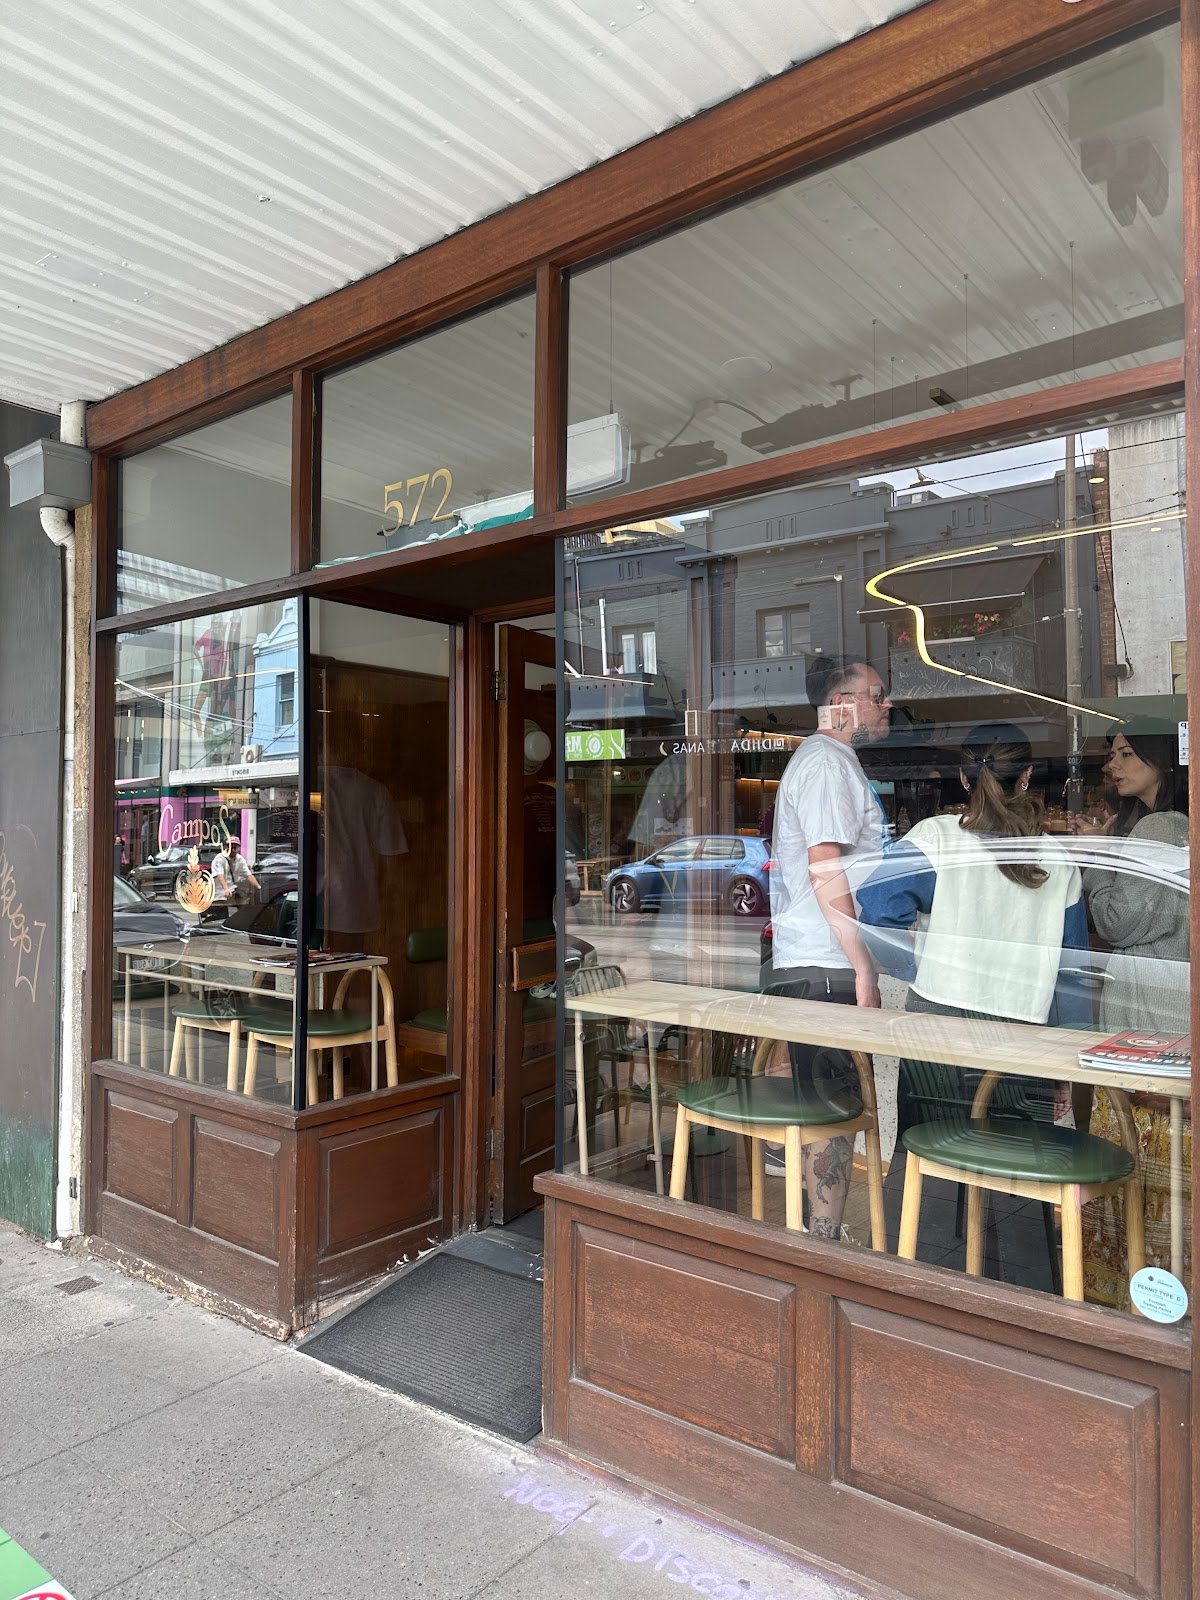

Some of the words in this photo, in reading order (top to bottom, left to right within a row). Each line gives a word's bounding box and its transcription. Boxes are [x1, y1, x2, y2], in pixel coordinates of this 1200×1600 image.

[384, 468, 452, 537] 572
[1137, 1284, 1158, 1294] PERMIT
[1159, 1290, 1174, 1299] TYPE
